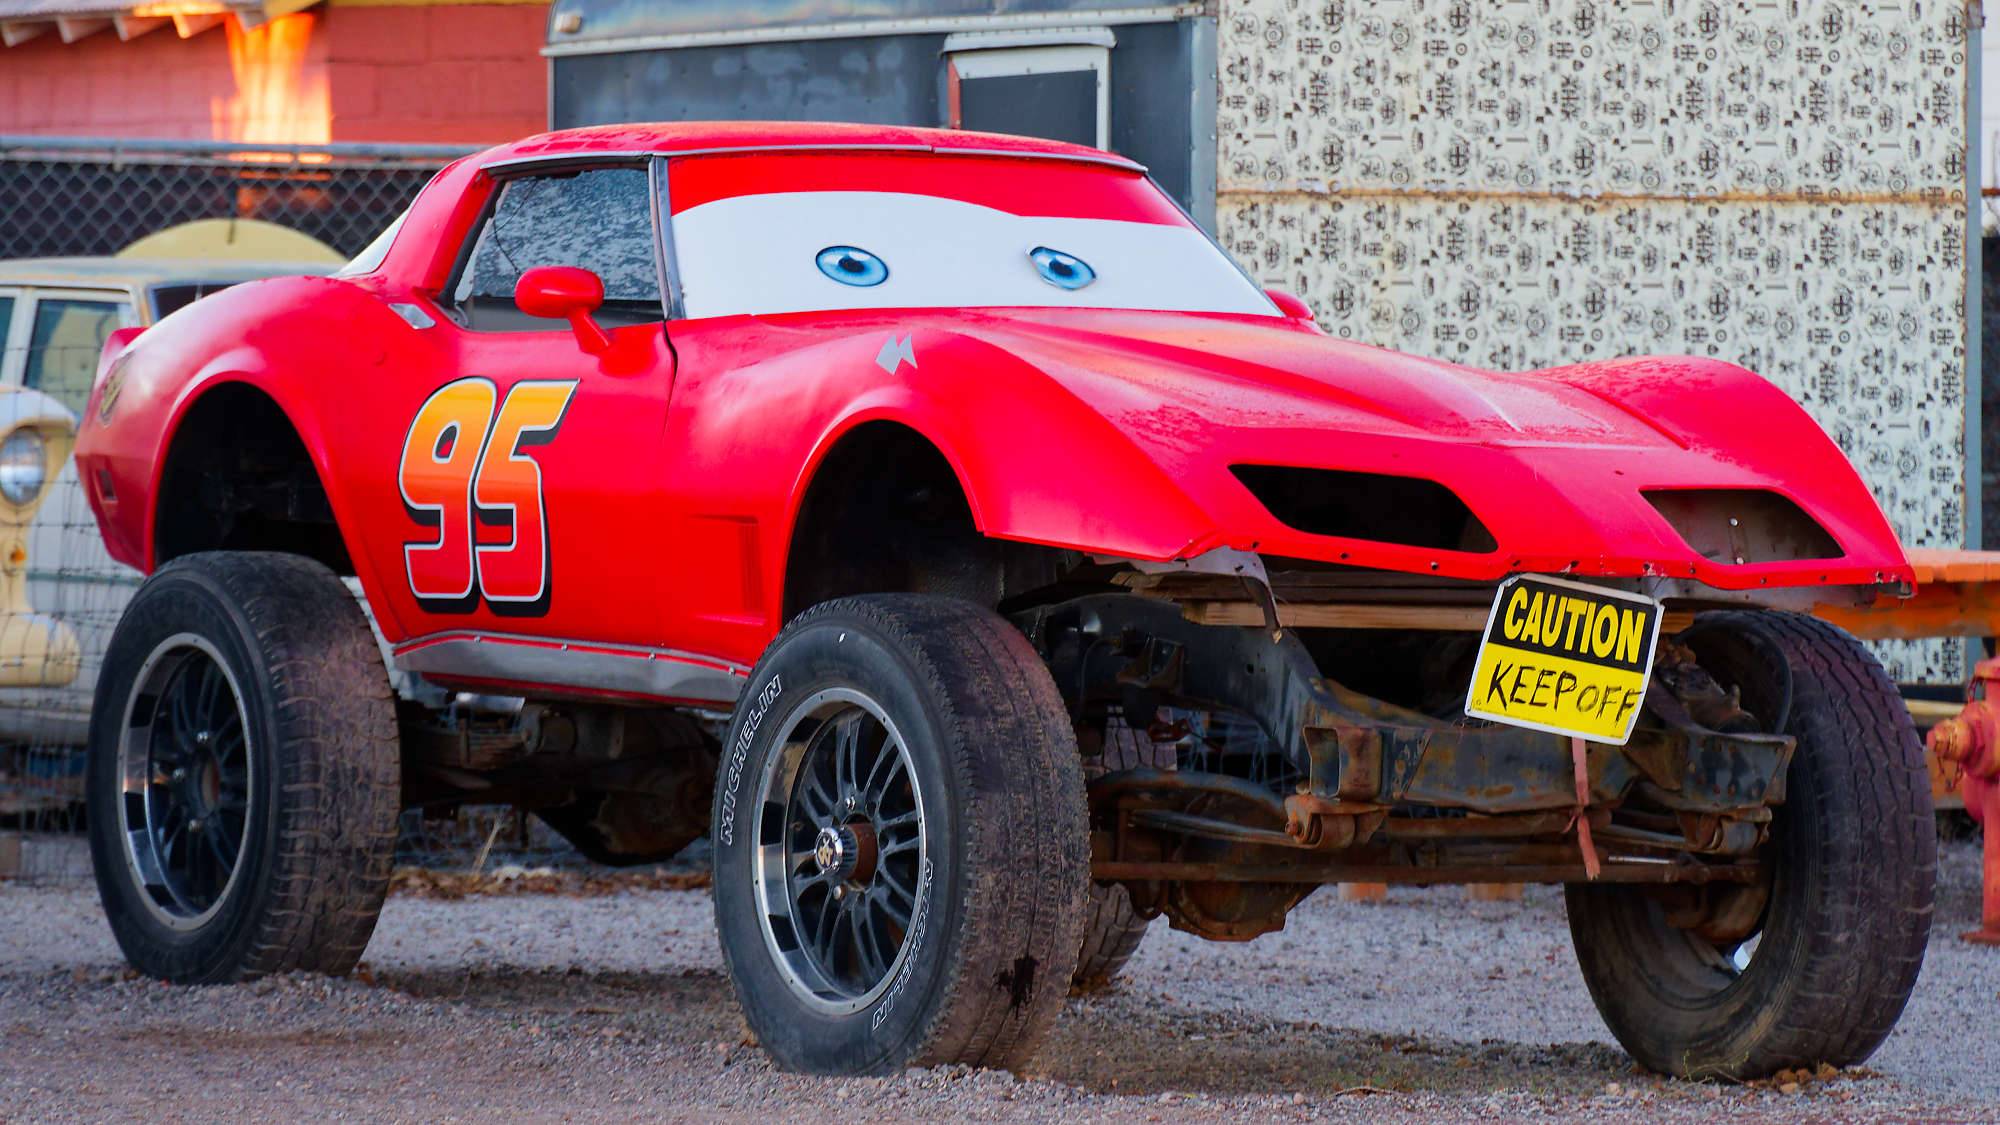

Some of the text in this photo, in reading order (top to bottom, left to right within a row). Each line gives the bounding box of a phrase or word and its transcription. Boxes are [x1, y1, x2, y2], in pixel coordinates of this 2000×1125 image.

[398, 376, 583, 617] 95
[1504, 587, 1646, 664] CAUTION
[1487, 660, 1577, 712] KEEP
[1576, 685, 1644, 727] OFF
[720, 674, 782, 846] MICHELIN
